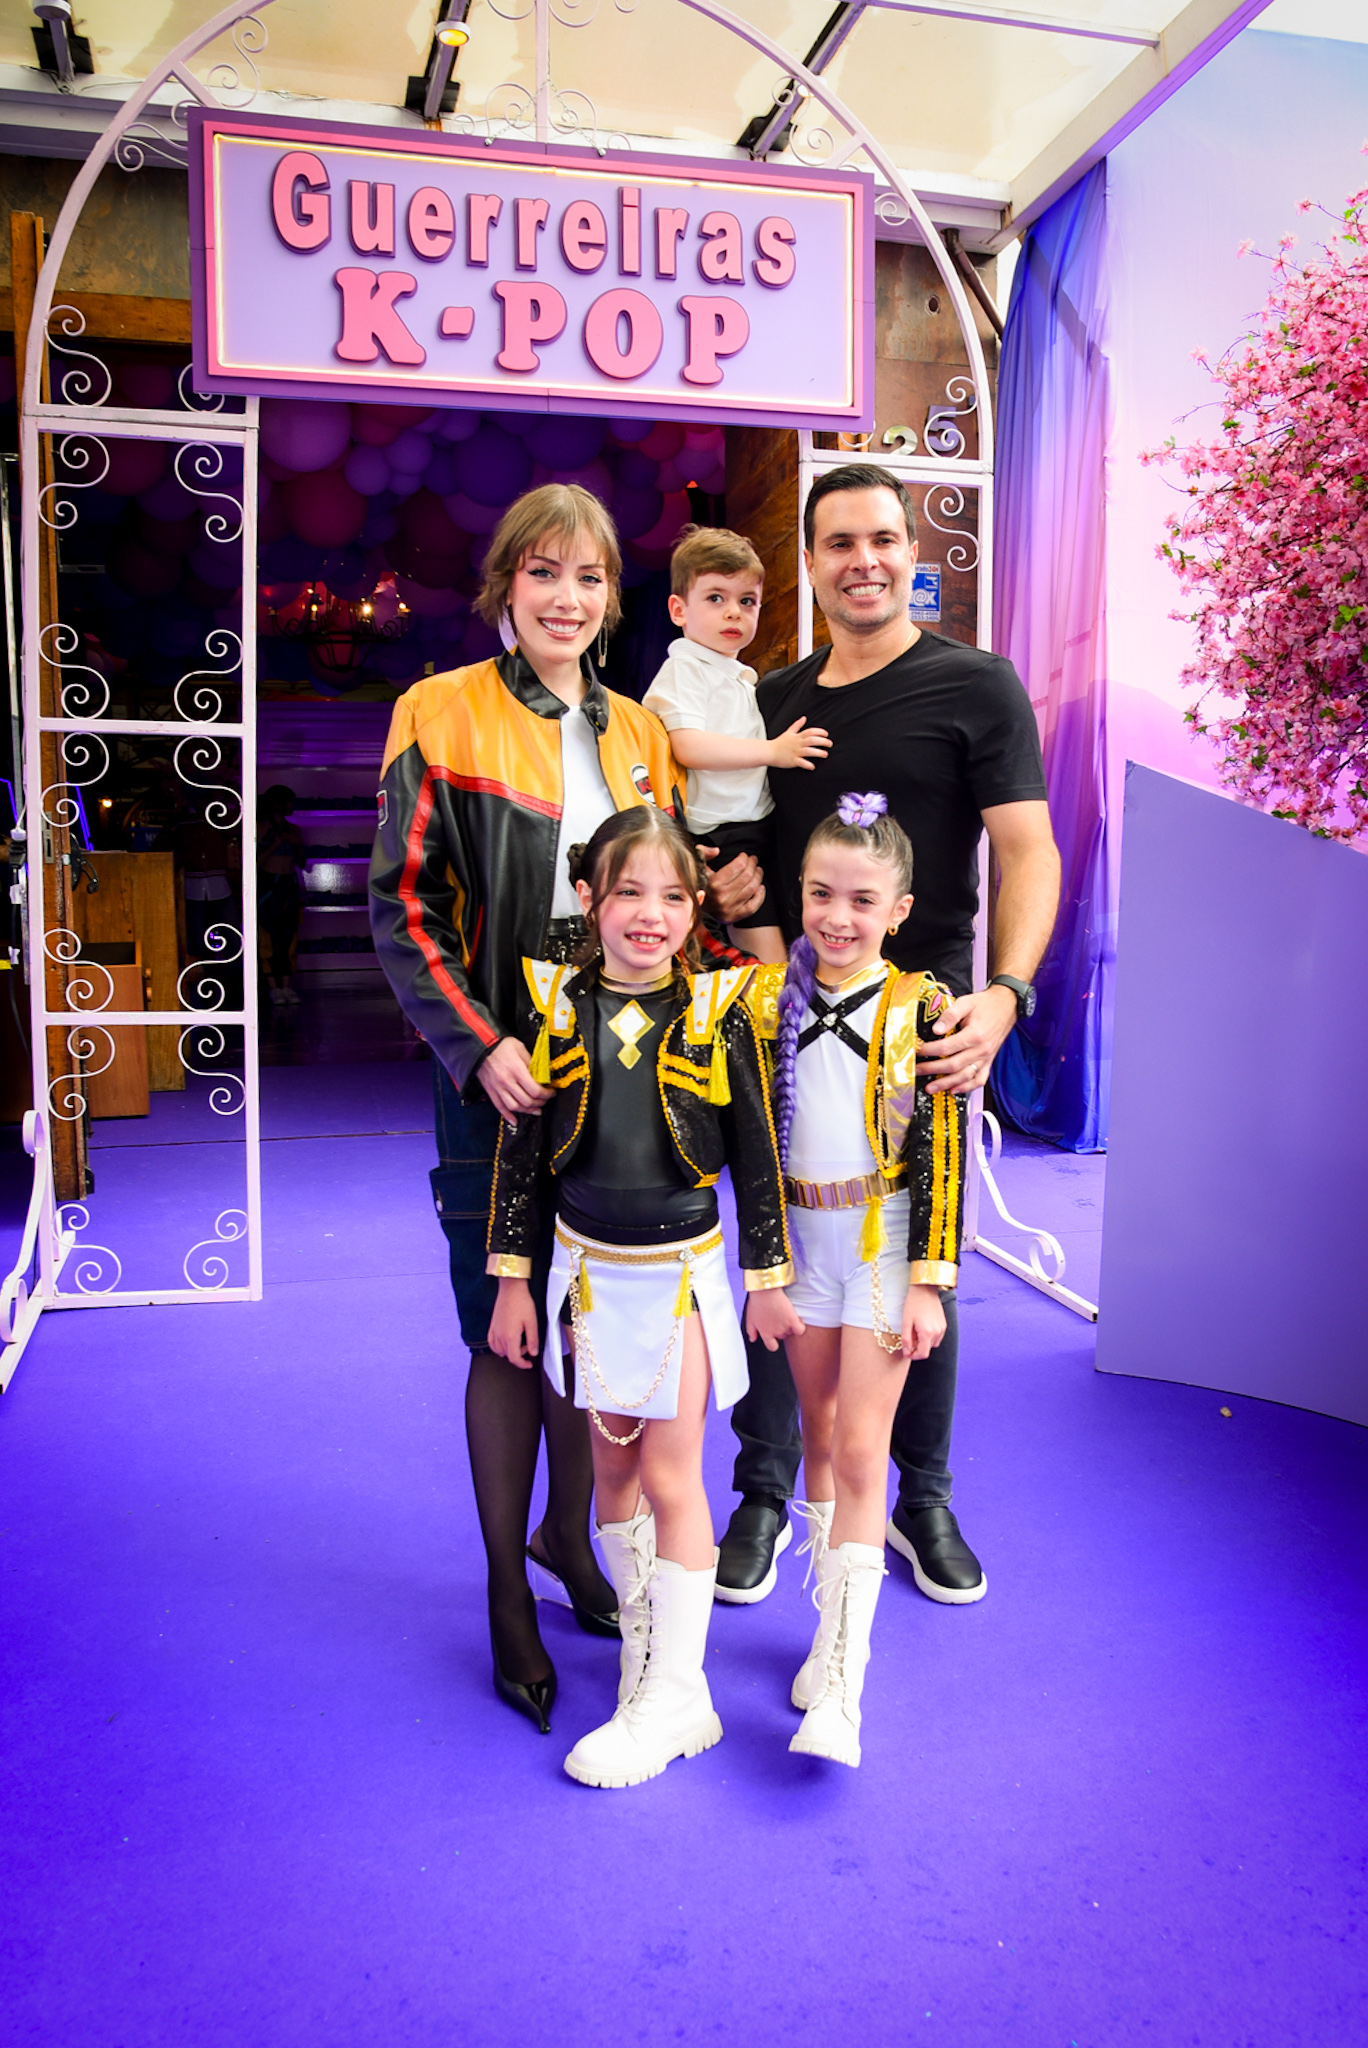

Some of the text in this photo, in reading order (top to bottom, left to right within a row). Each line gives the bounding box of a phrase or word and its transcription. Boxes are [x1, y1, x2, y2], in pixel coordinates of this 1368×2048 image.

[271, 150, 798, 289] Guerreiras
[333, 266, 751, 386] K-POP
[883, 397, 977, 456] 25
[910, 589, 937, 607] @X
